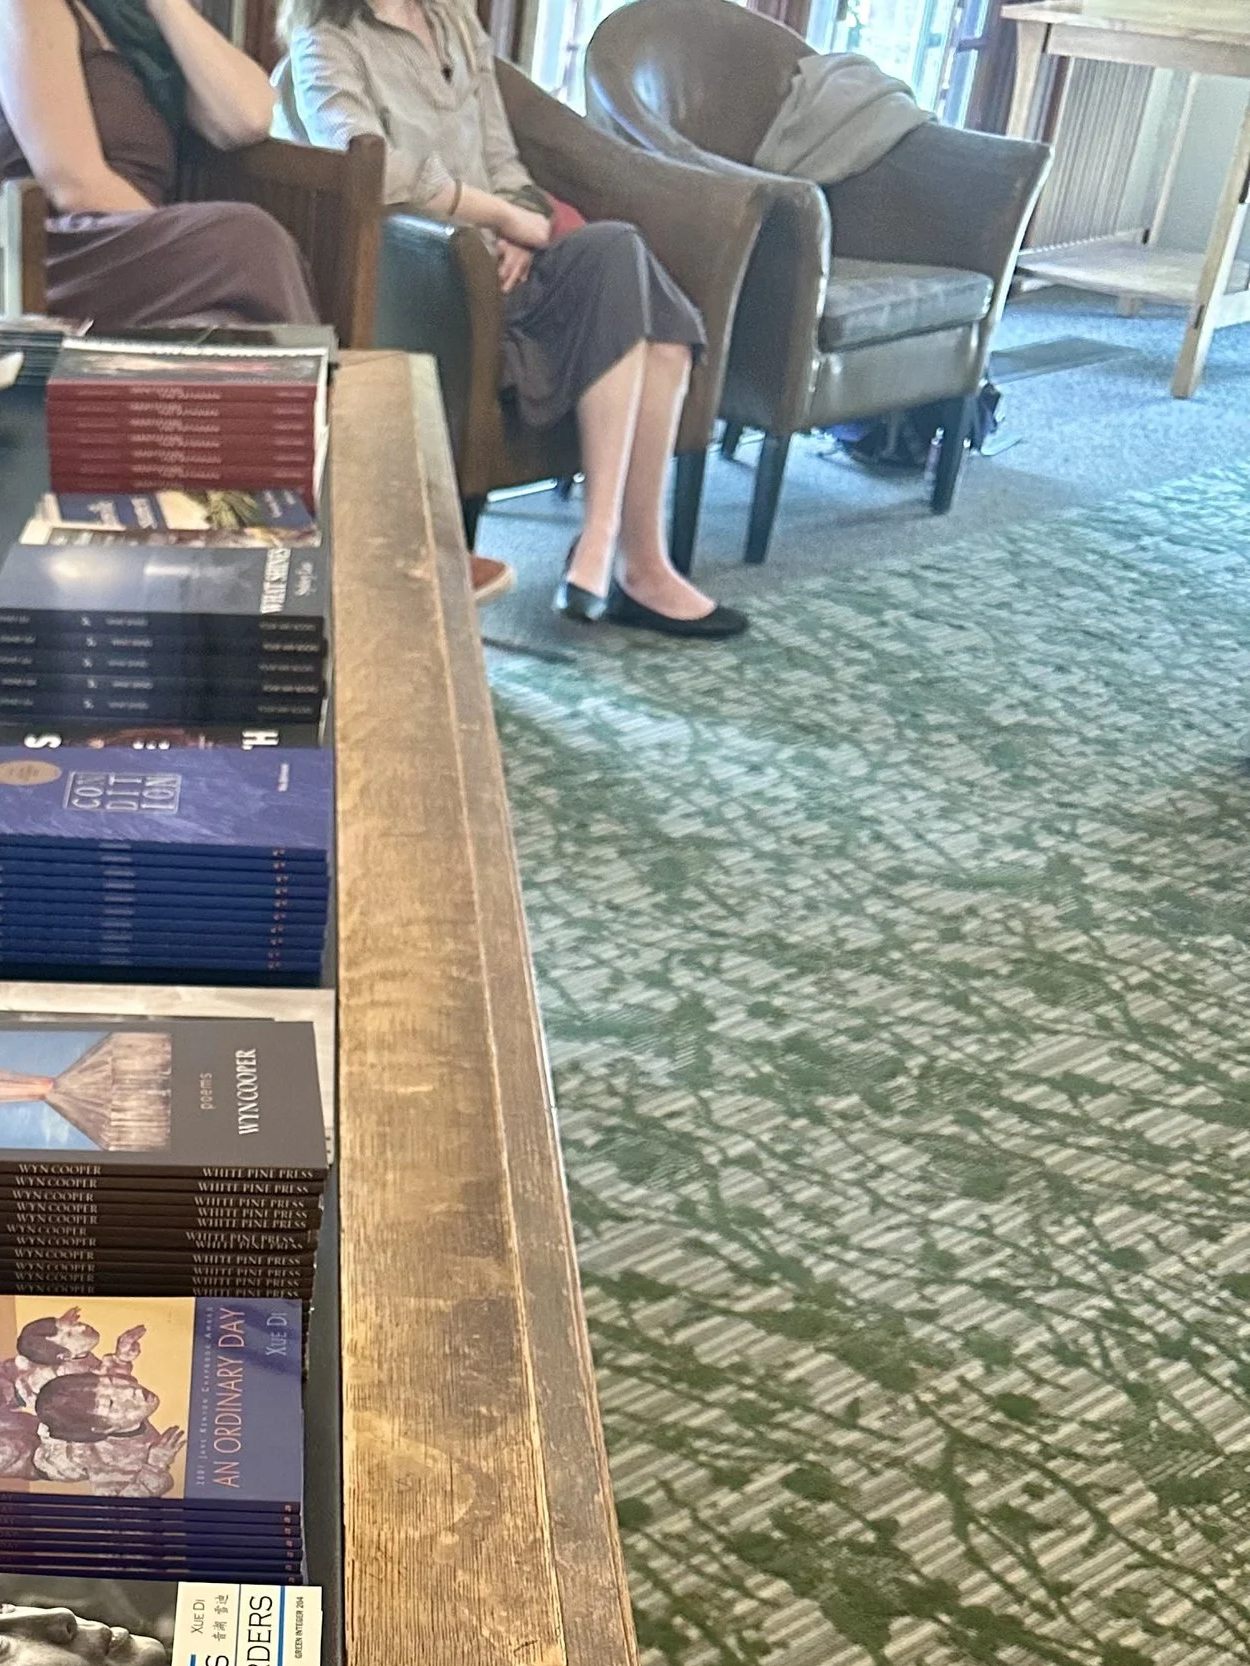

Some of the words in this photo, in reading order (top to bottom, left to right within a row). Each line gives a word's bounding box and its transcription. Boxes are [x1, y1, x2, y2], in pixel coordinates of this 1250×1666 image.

[236, 1048, 258, 1100] COOPER
[200, 1072, 215, 1110] poems
[238, 1101, 260, 1135] WYN
[19, 1164, 49, 1174] WYN
[50, 1166, 101, 1175] COOPER
[202, 1168, 245, 1178] WHITE
[247, 1169, 274, 1179] PINE
[276, 1170, 313, 1179] PRESS
[218, 1307, 246, 1348] DAY
[213, 1355, 244, 1454] ORDINARY
[213, 1461, 240, 1488] AN
[296, 1610, 304, 1636] INTEGER
[295, 1637, 303, 1659] GREEN
